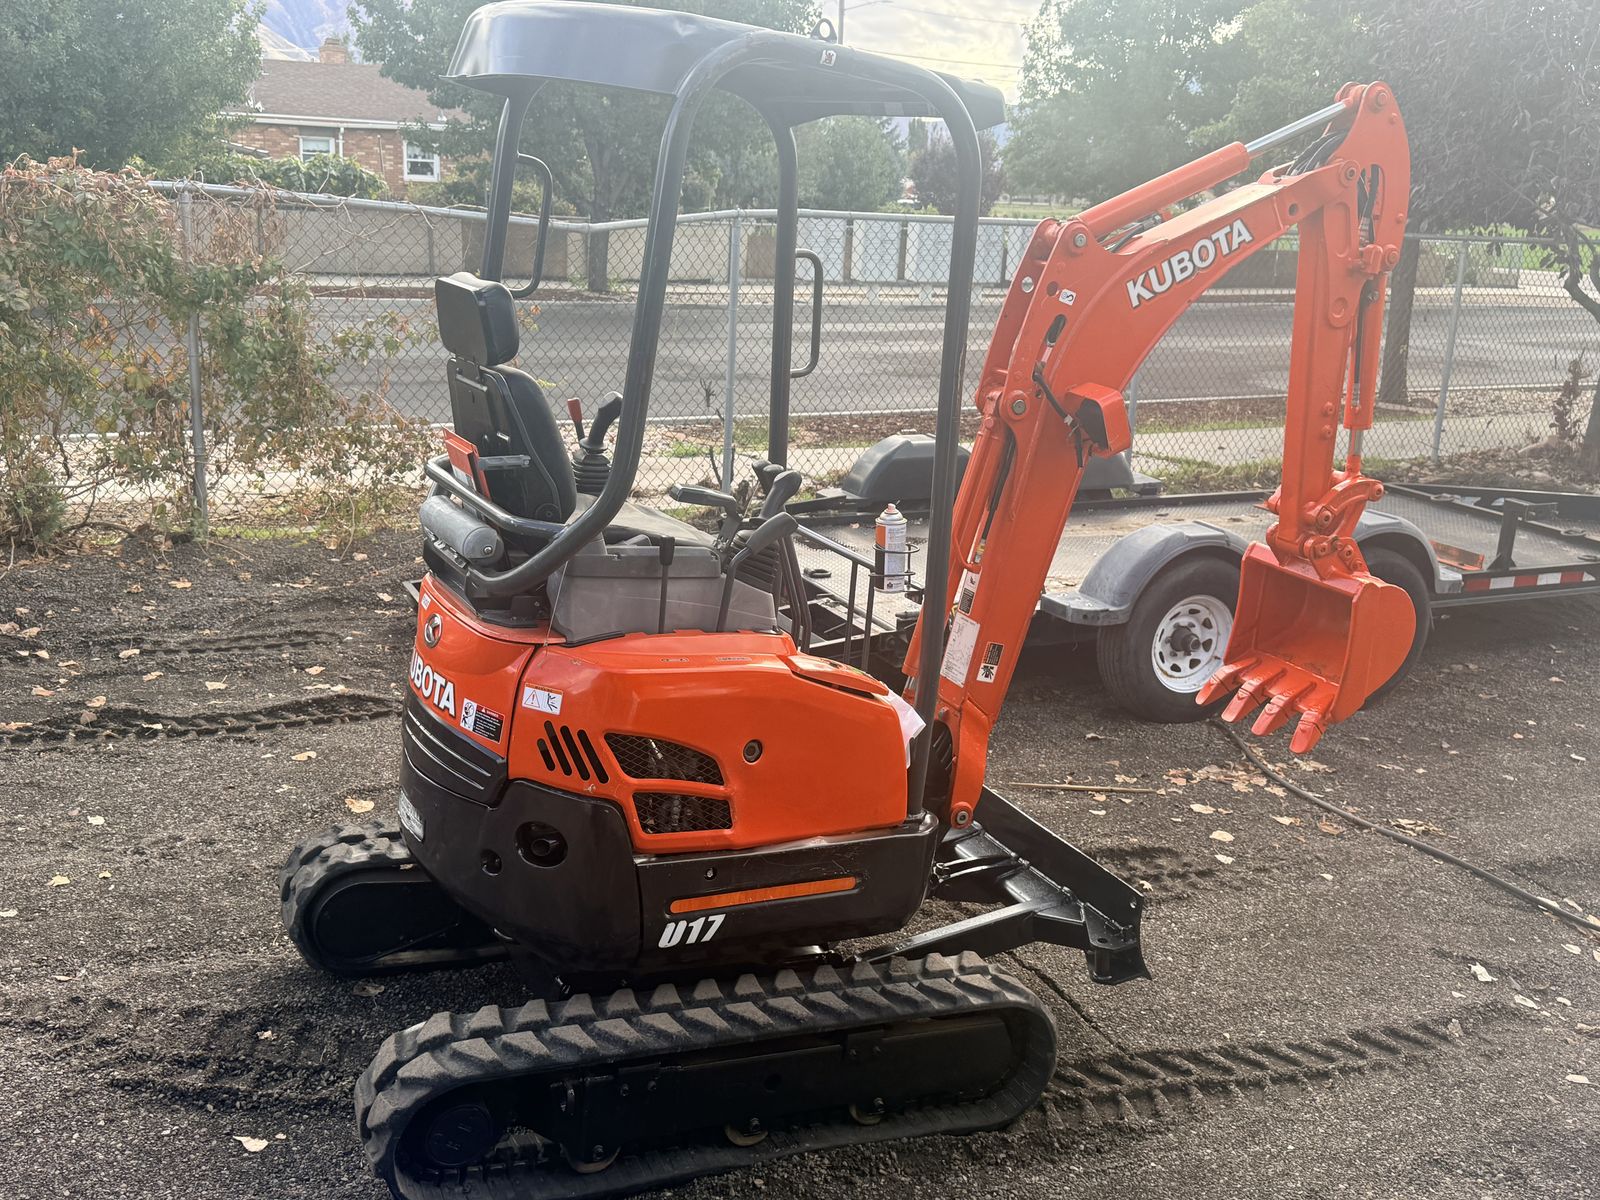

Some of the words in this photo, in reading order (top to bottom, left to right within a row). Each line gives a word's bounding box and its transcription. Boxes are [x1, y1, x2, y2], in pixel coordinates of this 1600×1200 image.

[1126, 218, 1253, 308] KUBOTA
[410, 649, 456, 718] UBOTA
[658, 914, 726, 948] U17
